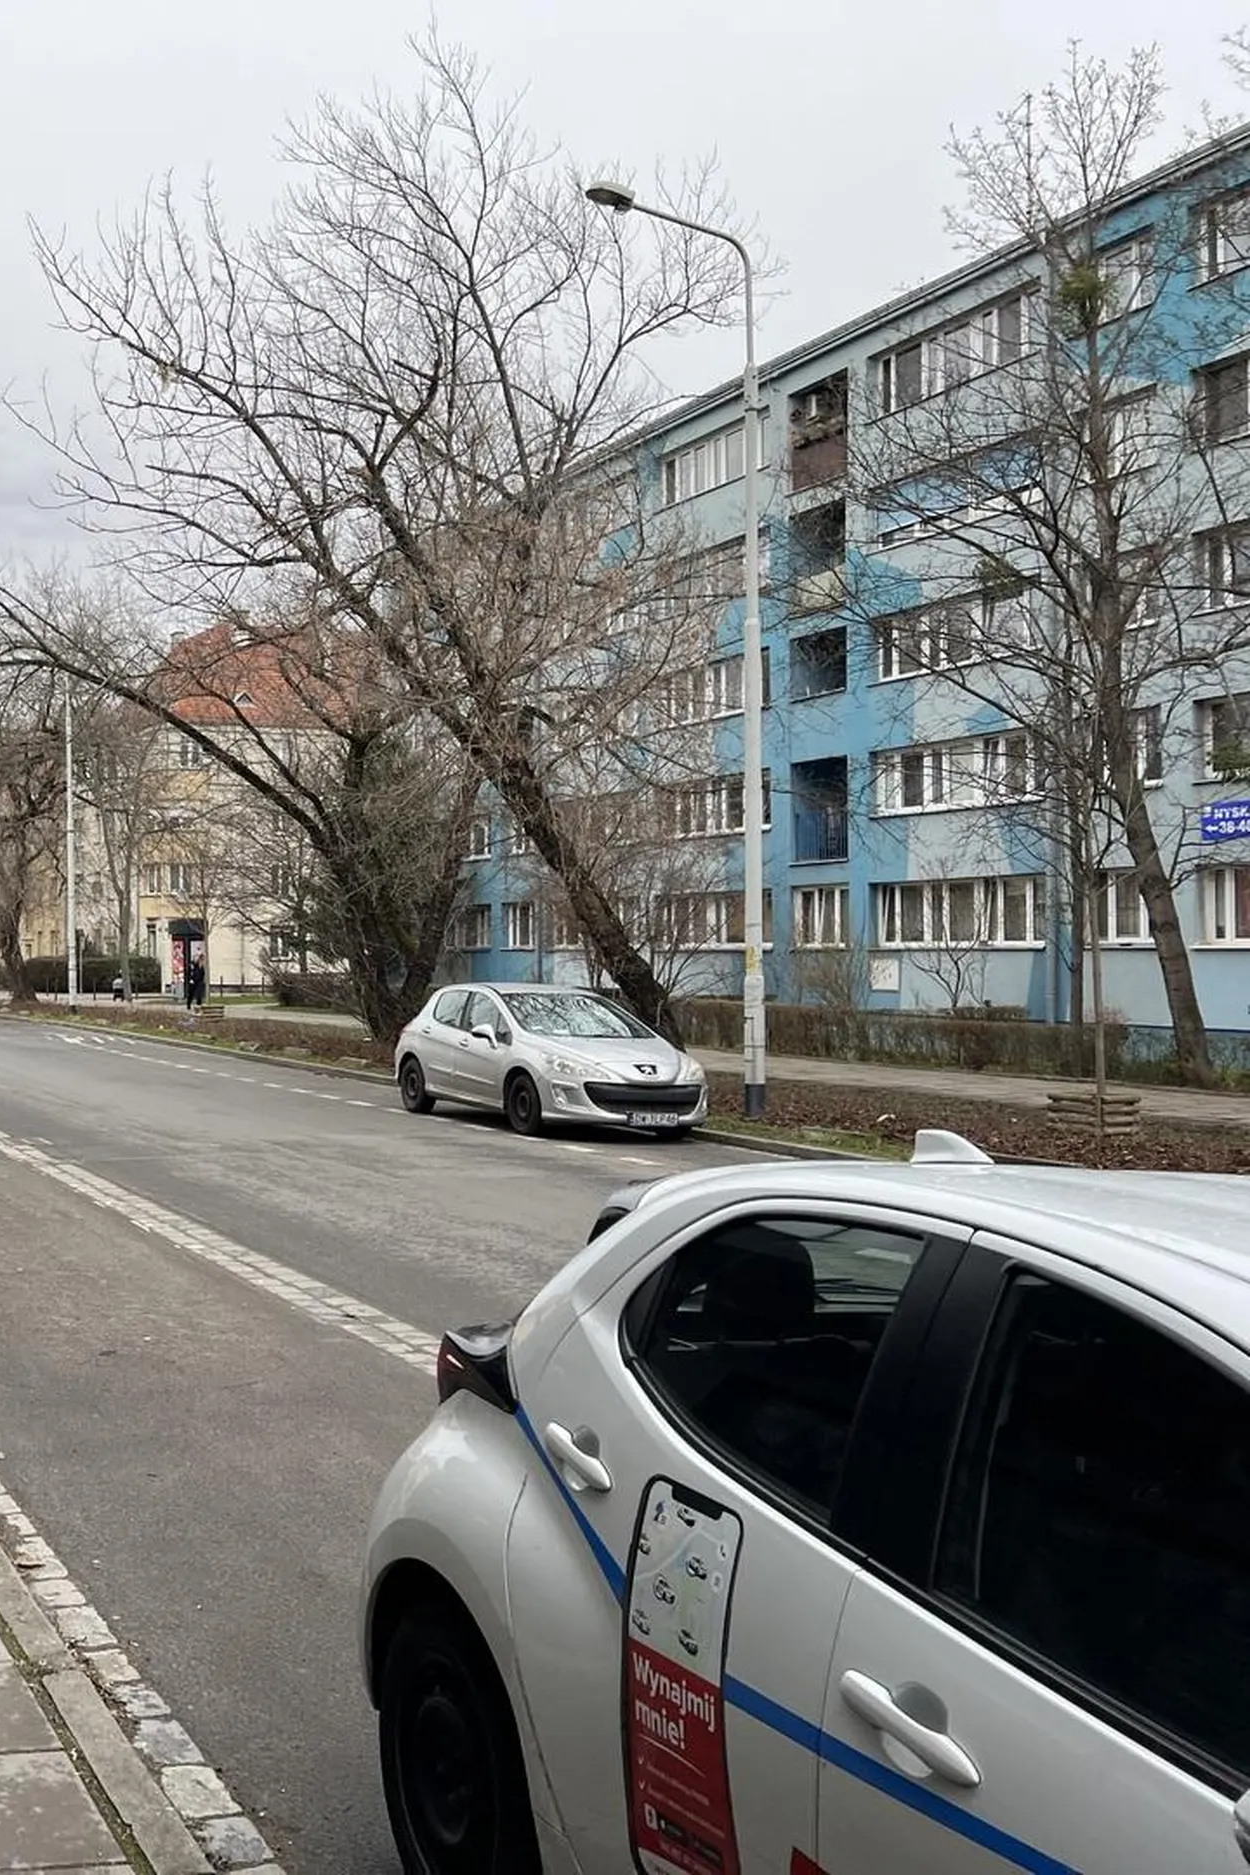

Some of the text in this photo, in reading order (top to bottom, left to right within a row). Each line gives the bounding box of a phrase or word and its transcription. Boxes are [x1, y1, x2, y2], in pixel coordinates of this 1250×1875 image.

[1213, 806, 1250, 820] NYSK
[632, 1651, 715, 1733] Wynajmij
[635, 1698, 685, 1750] mnie!
